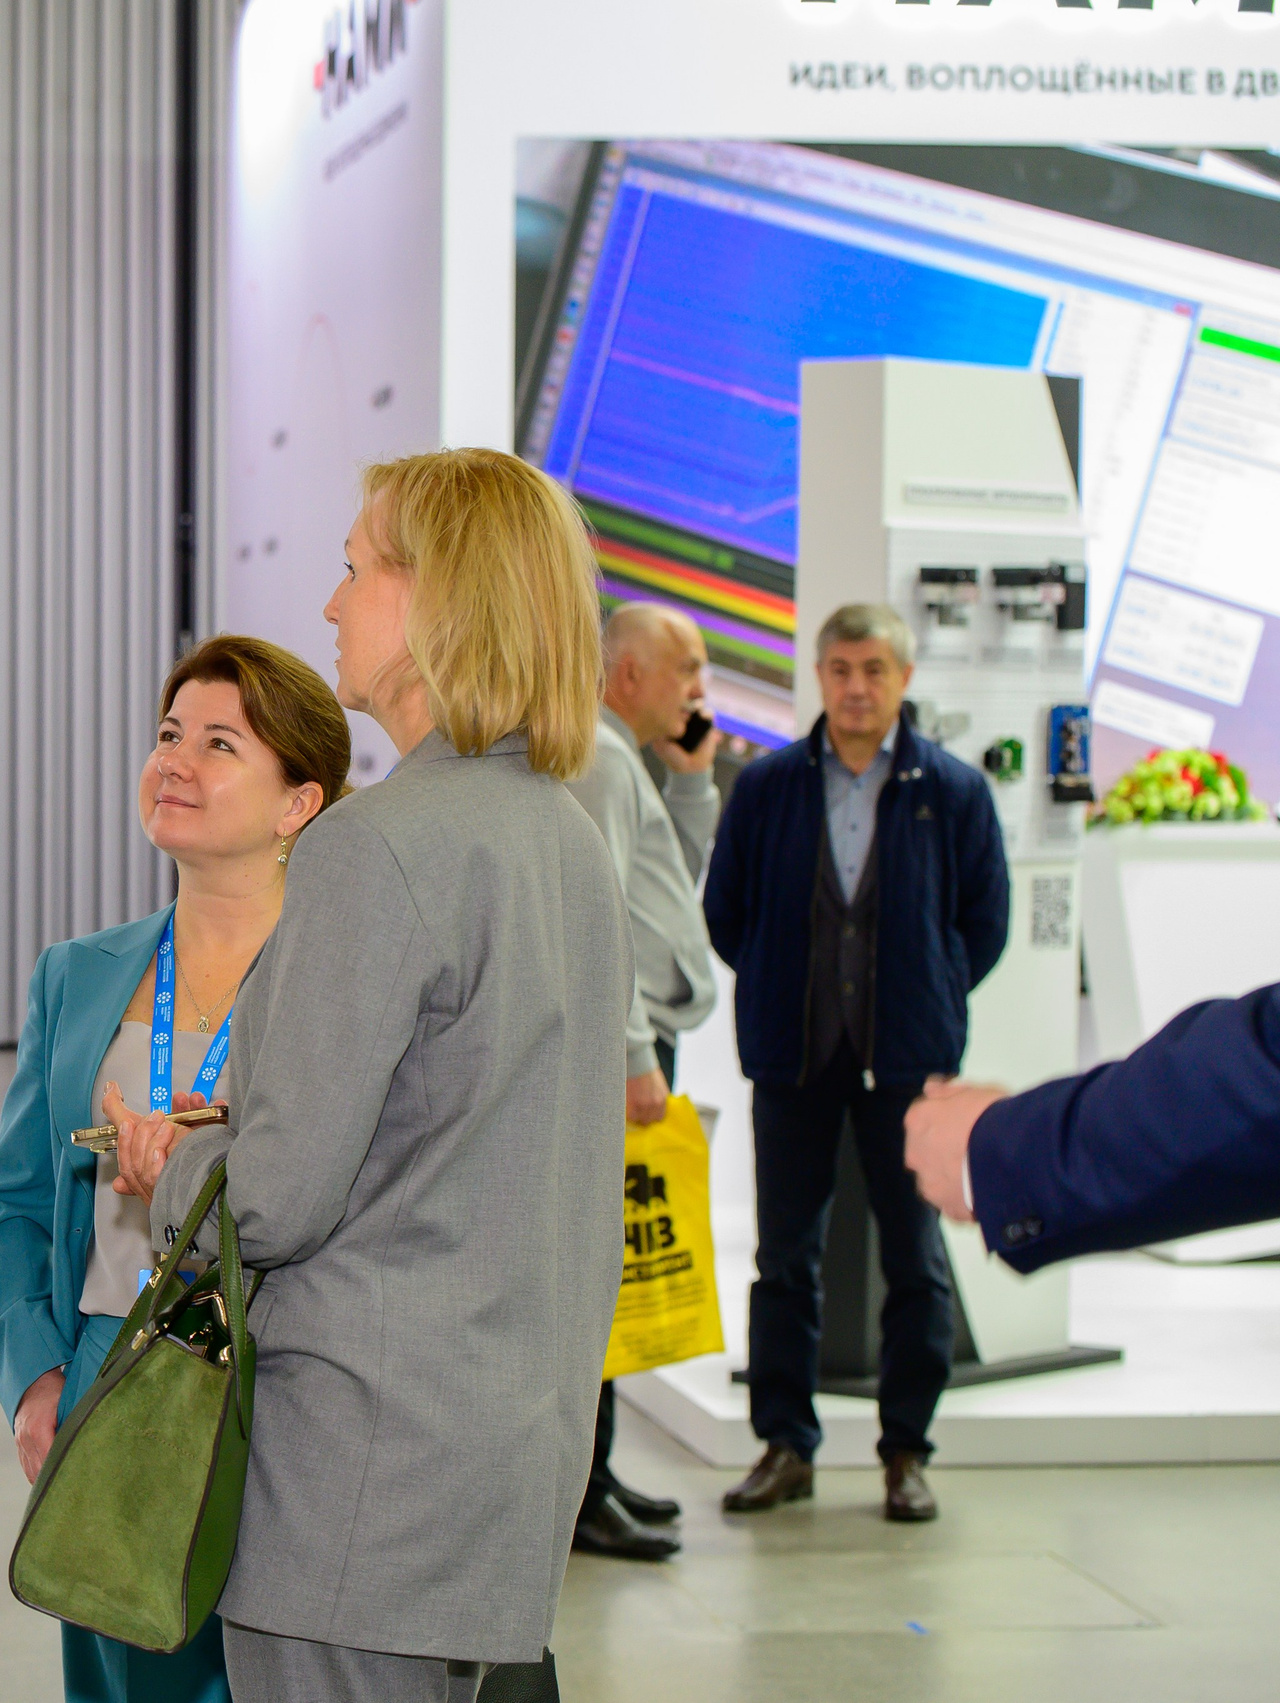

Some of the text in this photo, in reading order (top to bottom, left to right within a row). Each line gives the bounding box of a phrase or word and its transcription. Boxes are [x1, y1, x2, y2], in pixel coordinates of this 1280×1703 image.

[789, 60, 897, 94] ИДЕИ,
[906, 57, 1197, 98] ВОПЛОЩЁННЫЕ
[1207, 67, 1226, 96] В
